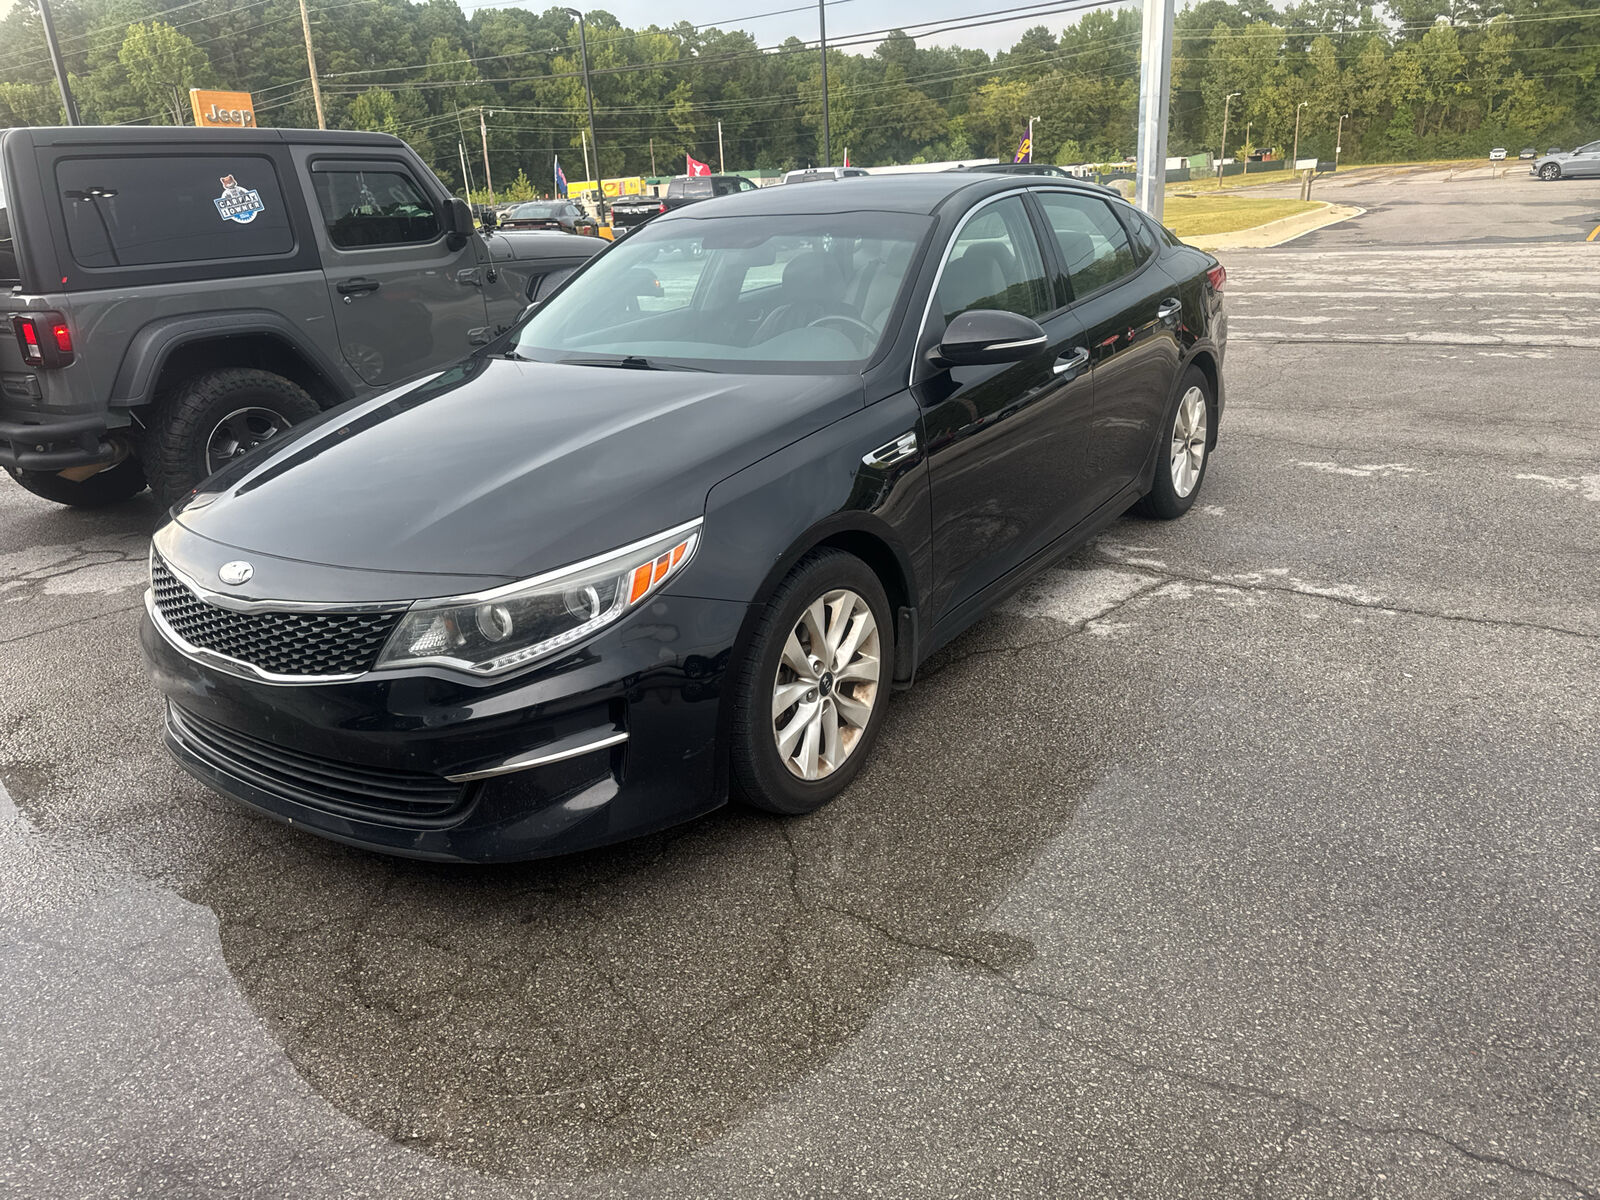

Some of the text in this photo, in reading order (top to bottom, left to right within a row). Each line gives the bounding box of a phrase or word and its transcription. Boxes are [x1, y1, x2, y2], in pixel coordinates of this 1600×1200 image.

[205, 103, 252, 127] Jeep
[219, 194, 257, 208] CARFAX
[229, 202, 260, 214] OWNER
